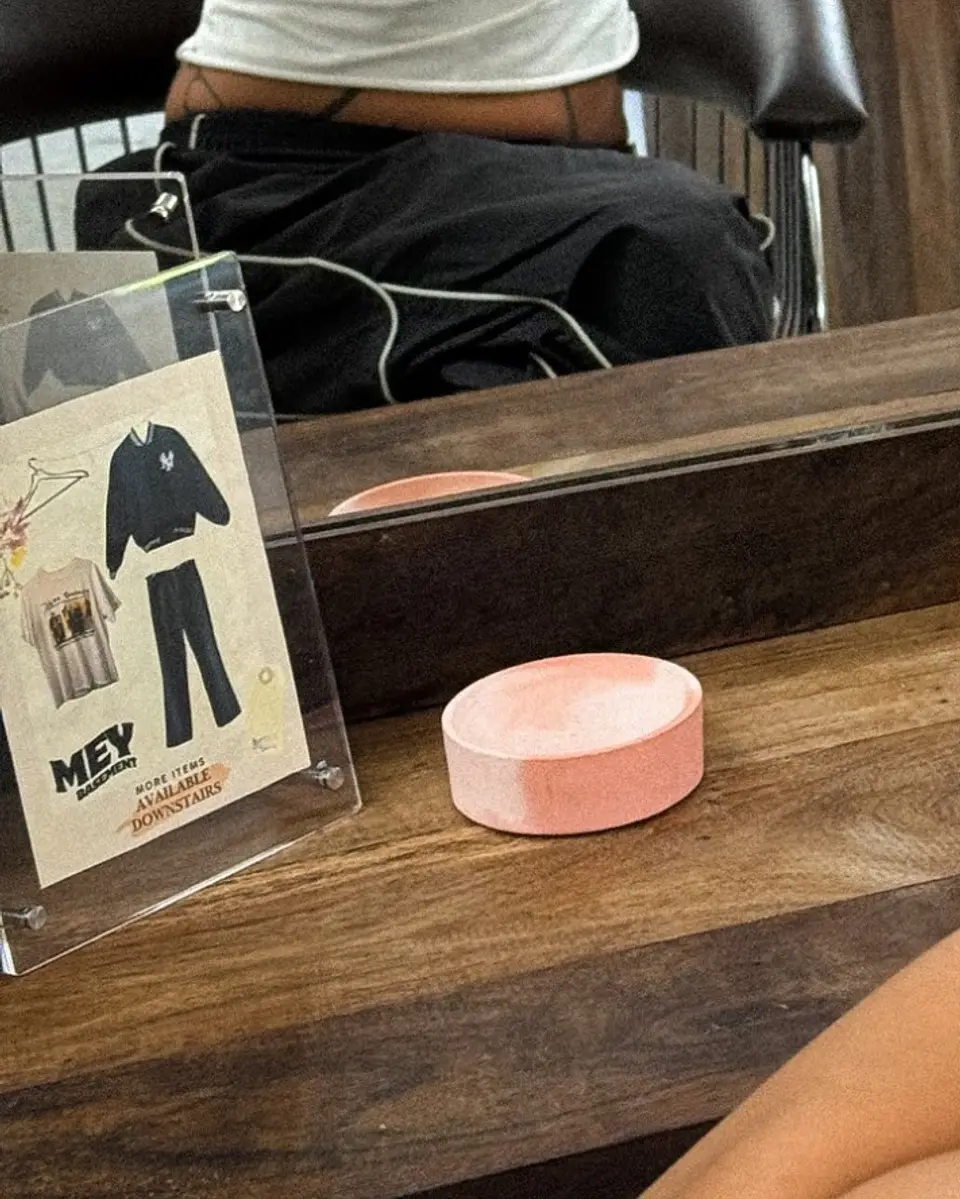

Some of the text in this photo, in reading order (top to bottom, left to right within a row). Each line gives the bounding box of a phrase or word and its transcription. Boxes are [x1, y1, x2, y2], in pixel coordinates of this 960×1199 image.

[49, 722, 134, 793] MEY
[76, 757, 137, 801] BASEMENT
[135, 757, 206, 795] MORE ITEMS
[132, 781, 223, 832] DOWNSTAIRS
[136, 768, 212, 813] AVAILABLE
